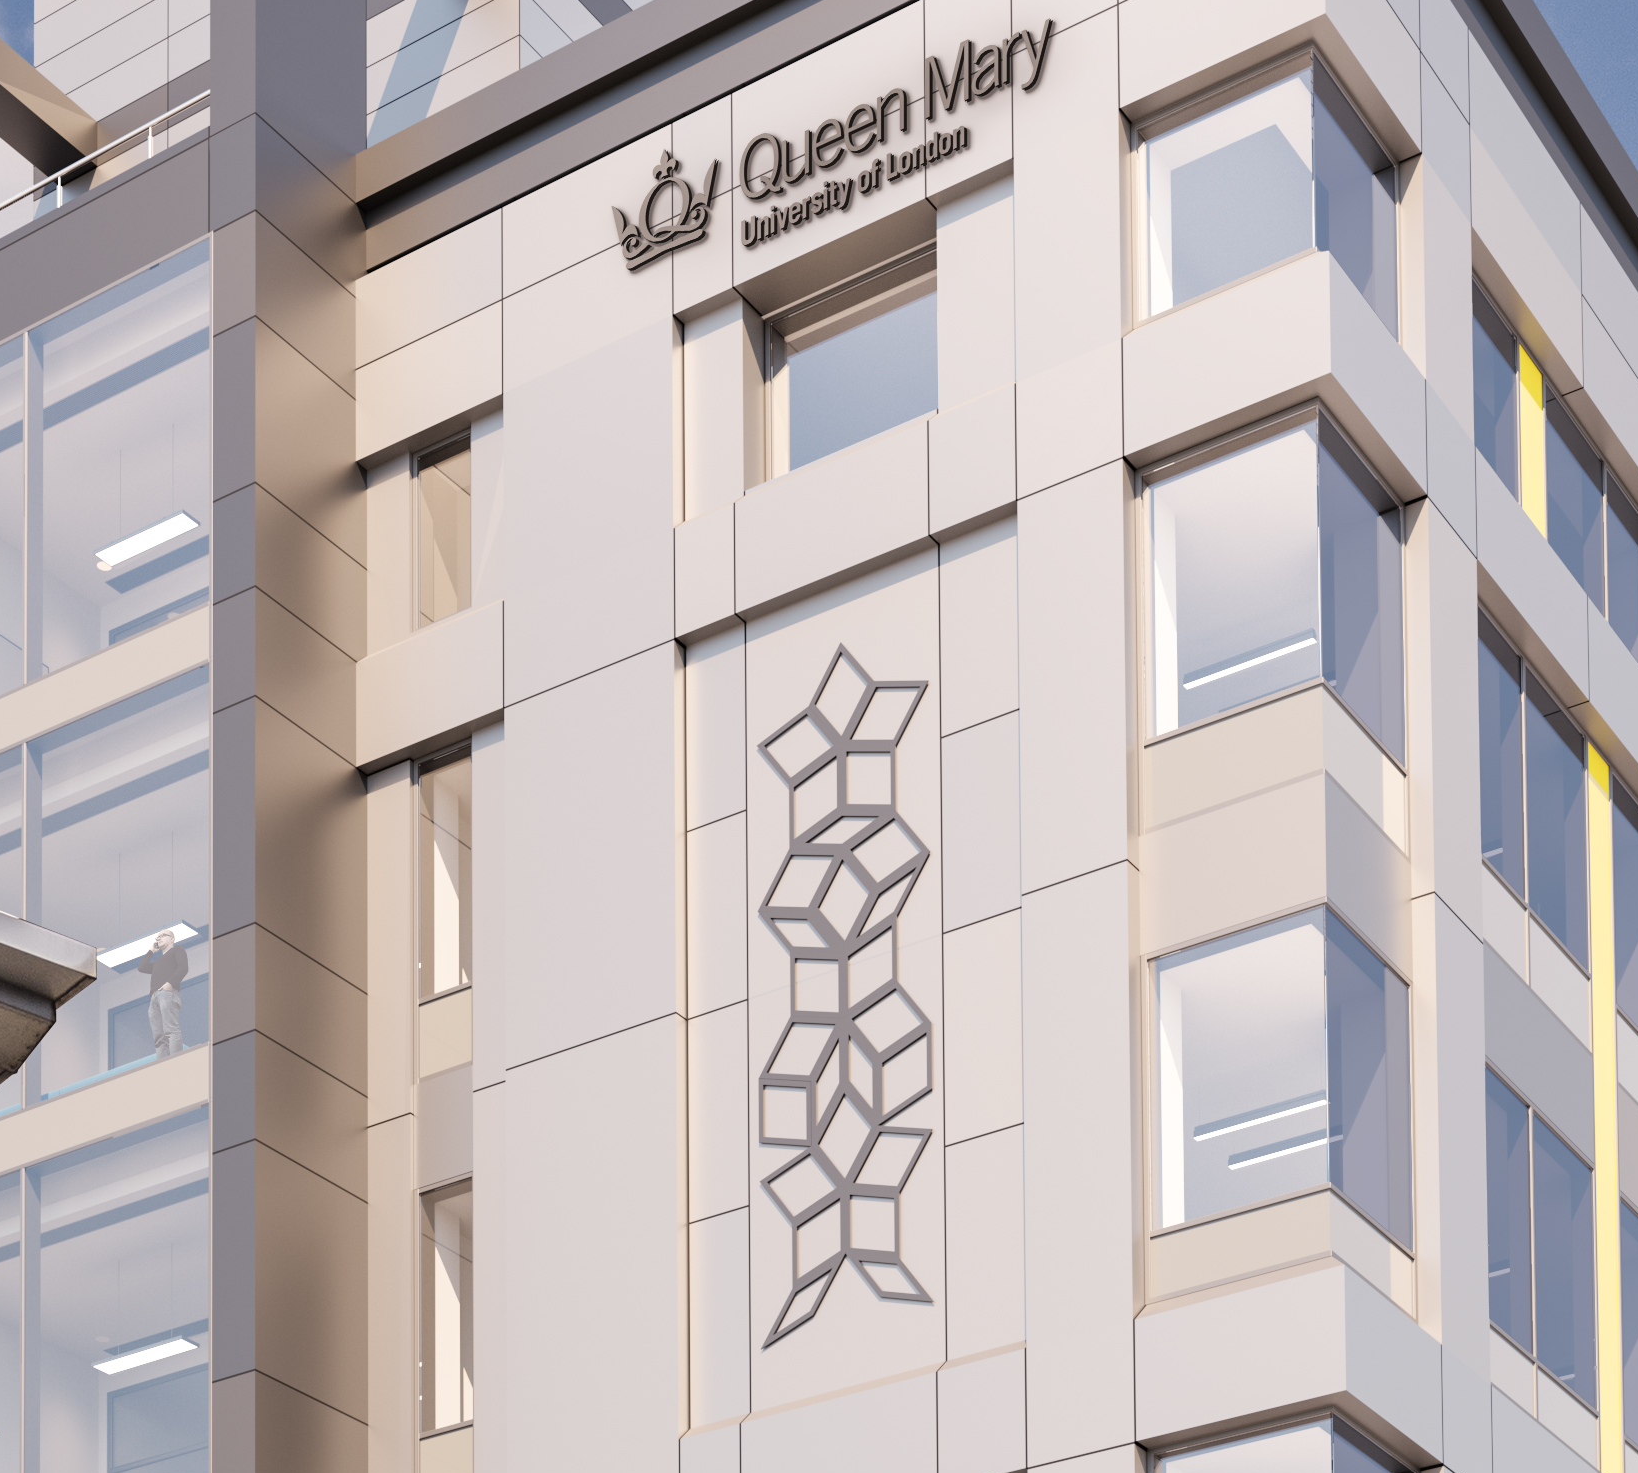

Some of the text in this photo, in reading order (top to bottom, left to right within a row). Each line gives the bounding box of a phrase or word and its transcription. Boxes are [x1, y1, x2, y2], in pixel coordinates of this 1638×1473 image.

[739, 18, 1053, 200] Queen Mary
[740, 125, 969, 249] University of London
